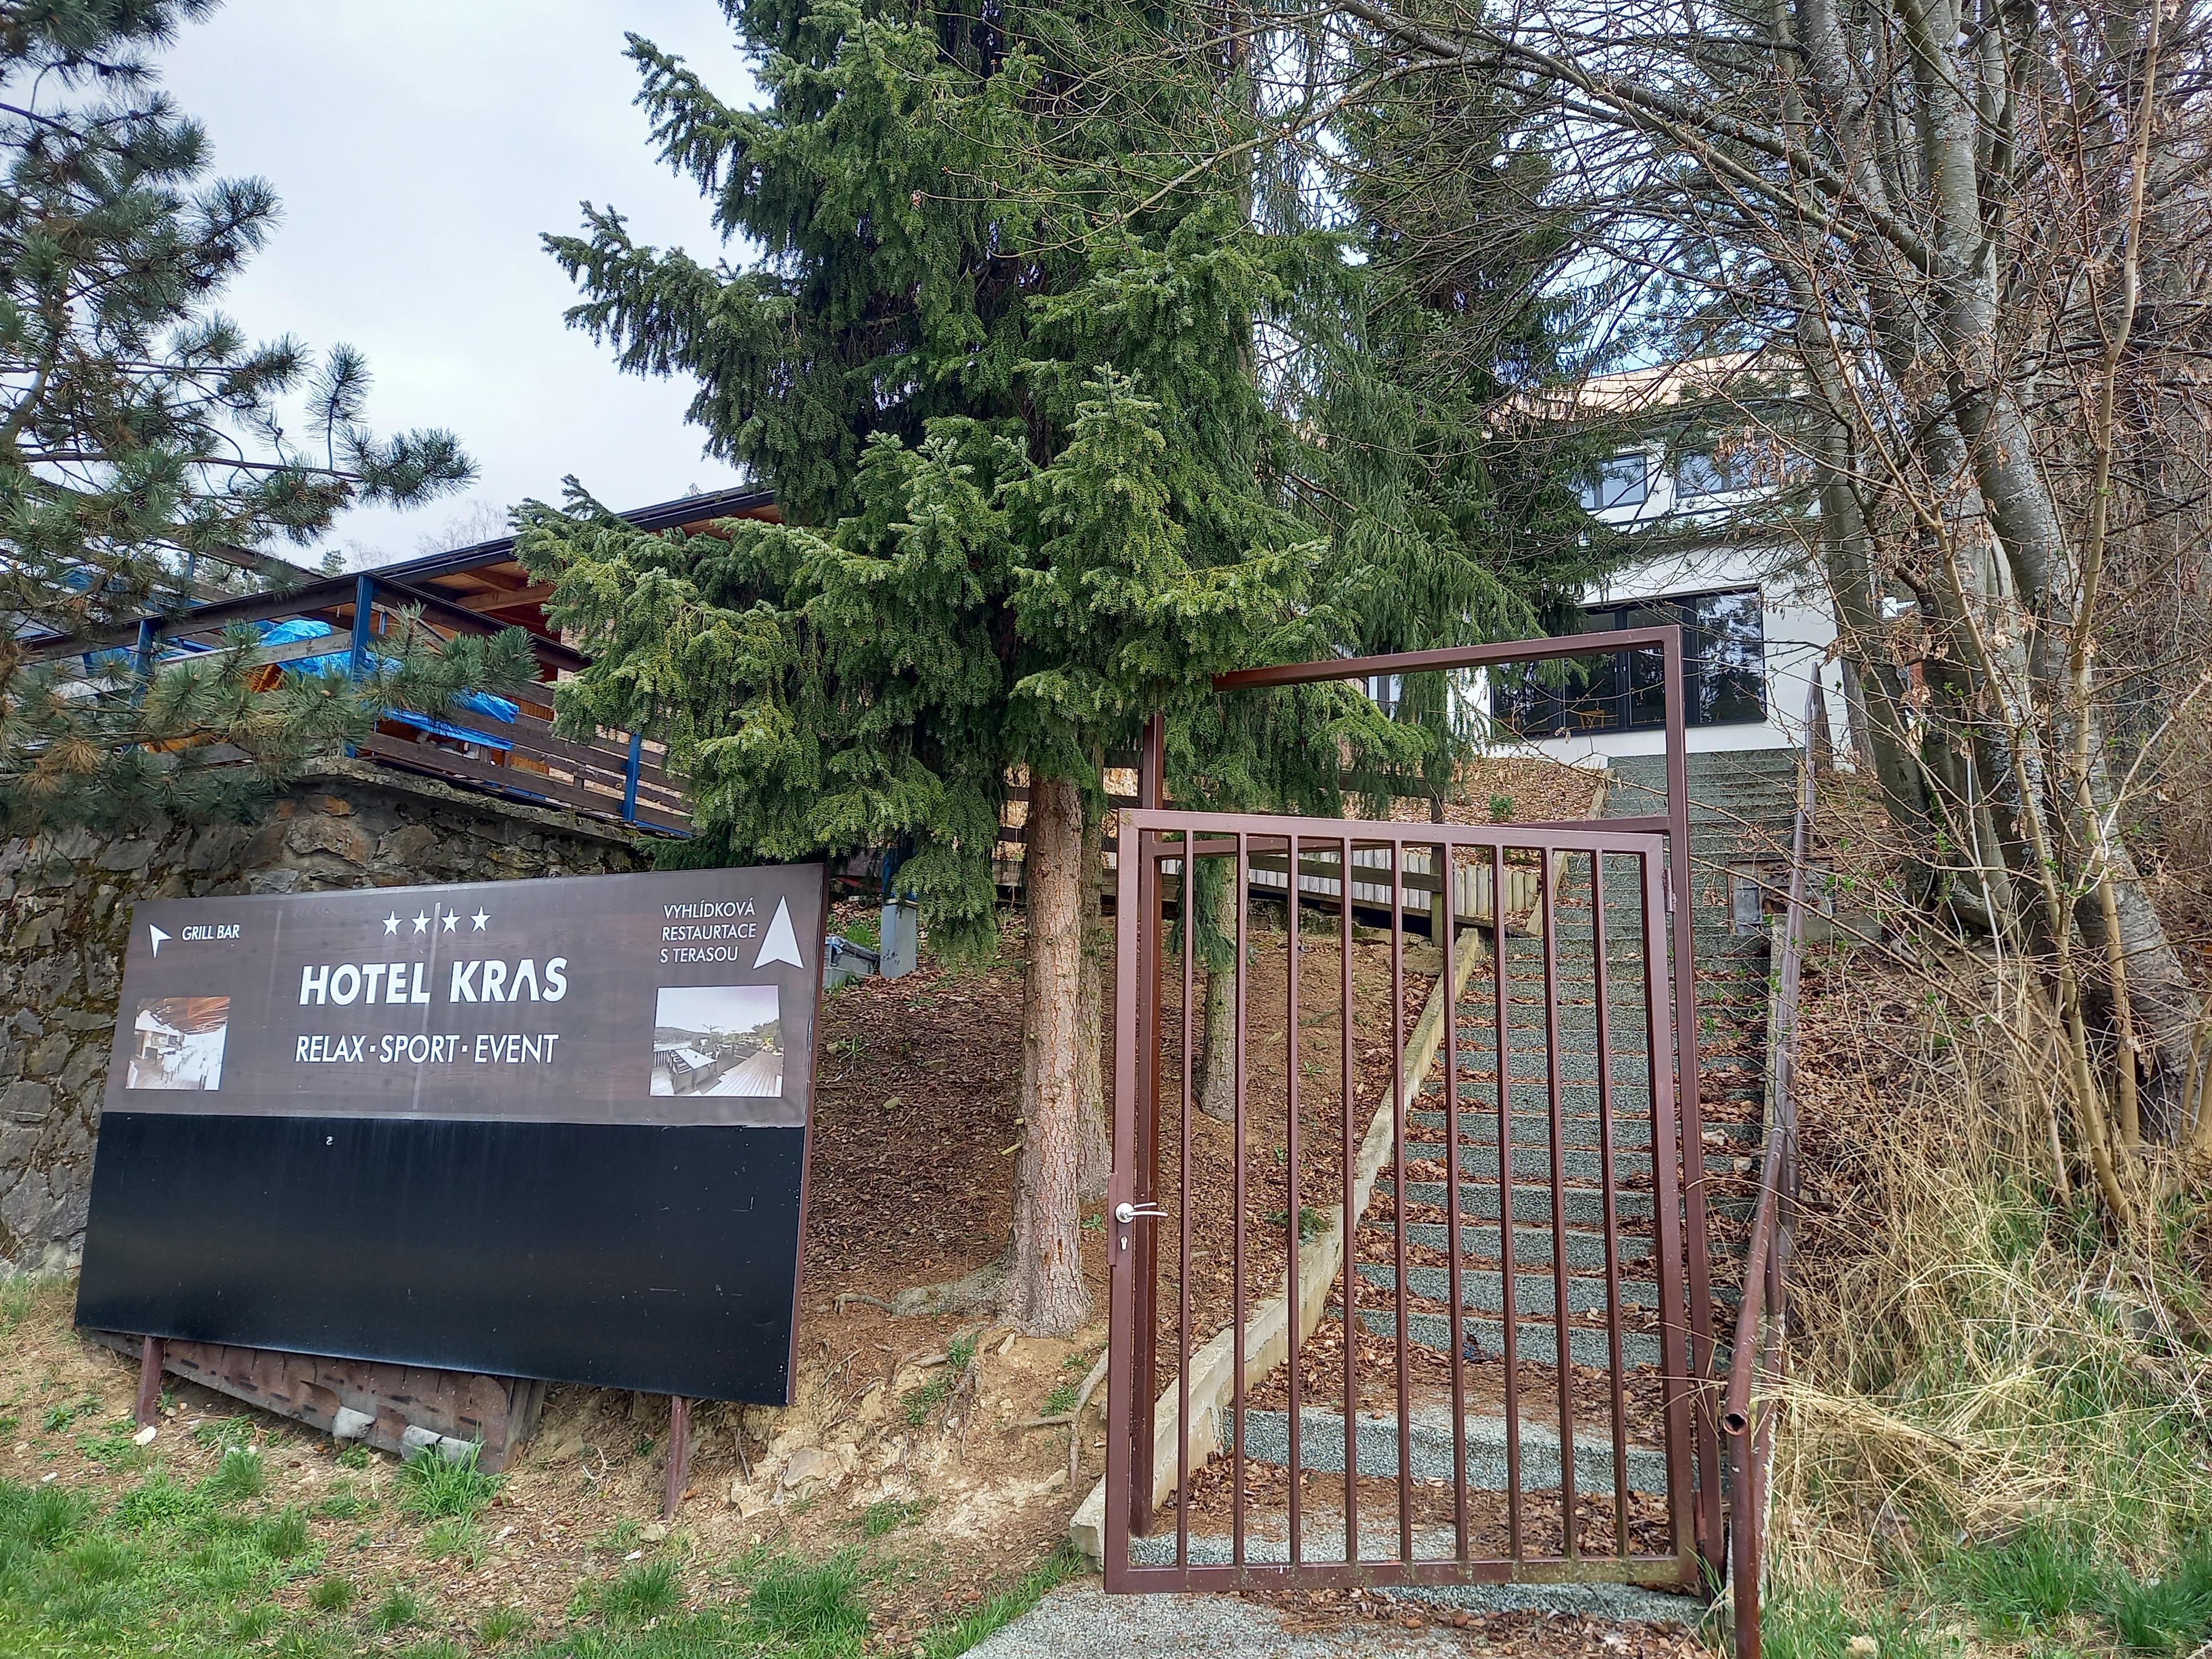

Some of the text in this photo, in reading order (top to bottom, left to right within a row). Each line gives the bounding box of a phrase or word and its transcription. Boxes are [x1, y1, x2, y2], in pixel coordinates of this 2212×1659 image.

[663, 897, 755, 920] VYHLÍDKOVÁ
[182, 924, 240, 941] GRILL BAR
[662, 923, 757, 941] RESTAURTACE
[660, 946, 738, 963] S TERASOU
[299, 957, 568, 1005] HOTEL KRAS
